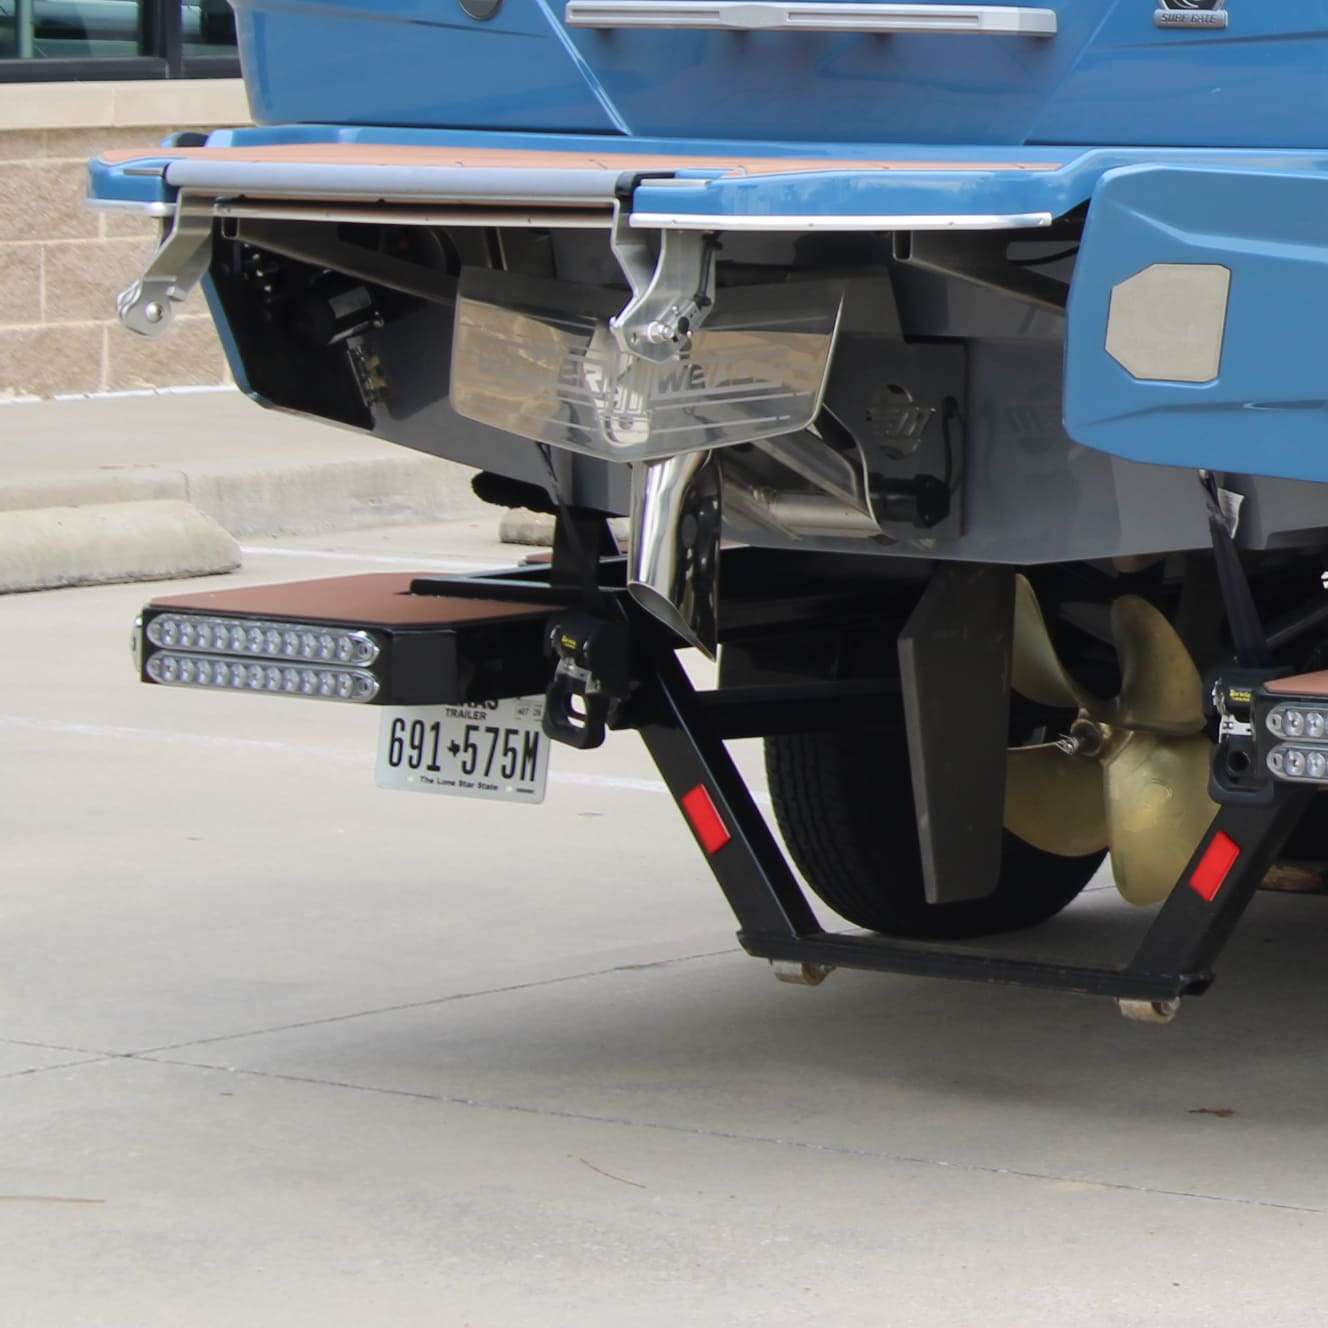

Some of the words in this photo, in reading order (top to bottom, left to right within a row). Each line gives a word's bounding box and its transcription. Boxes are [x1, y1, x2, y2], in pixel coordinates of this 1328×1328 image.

[1160, 13, 1187, 24] SURF
[1190, 13, 1217, 24] GATE
[445, 707, 488, 721] TRAILER
[388, 717, 442, 773] 691
[460, 724, 540, 782] 575M
[420, 775, 434, 784] The
[437, 777, 456, 786] Lone
[458, 779, 474, 788] Star
[478, 781, 499, 791] State
